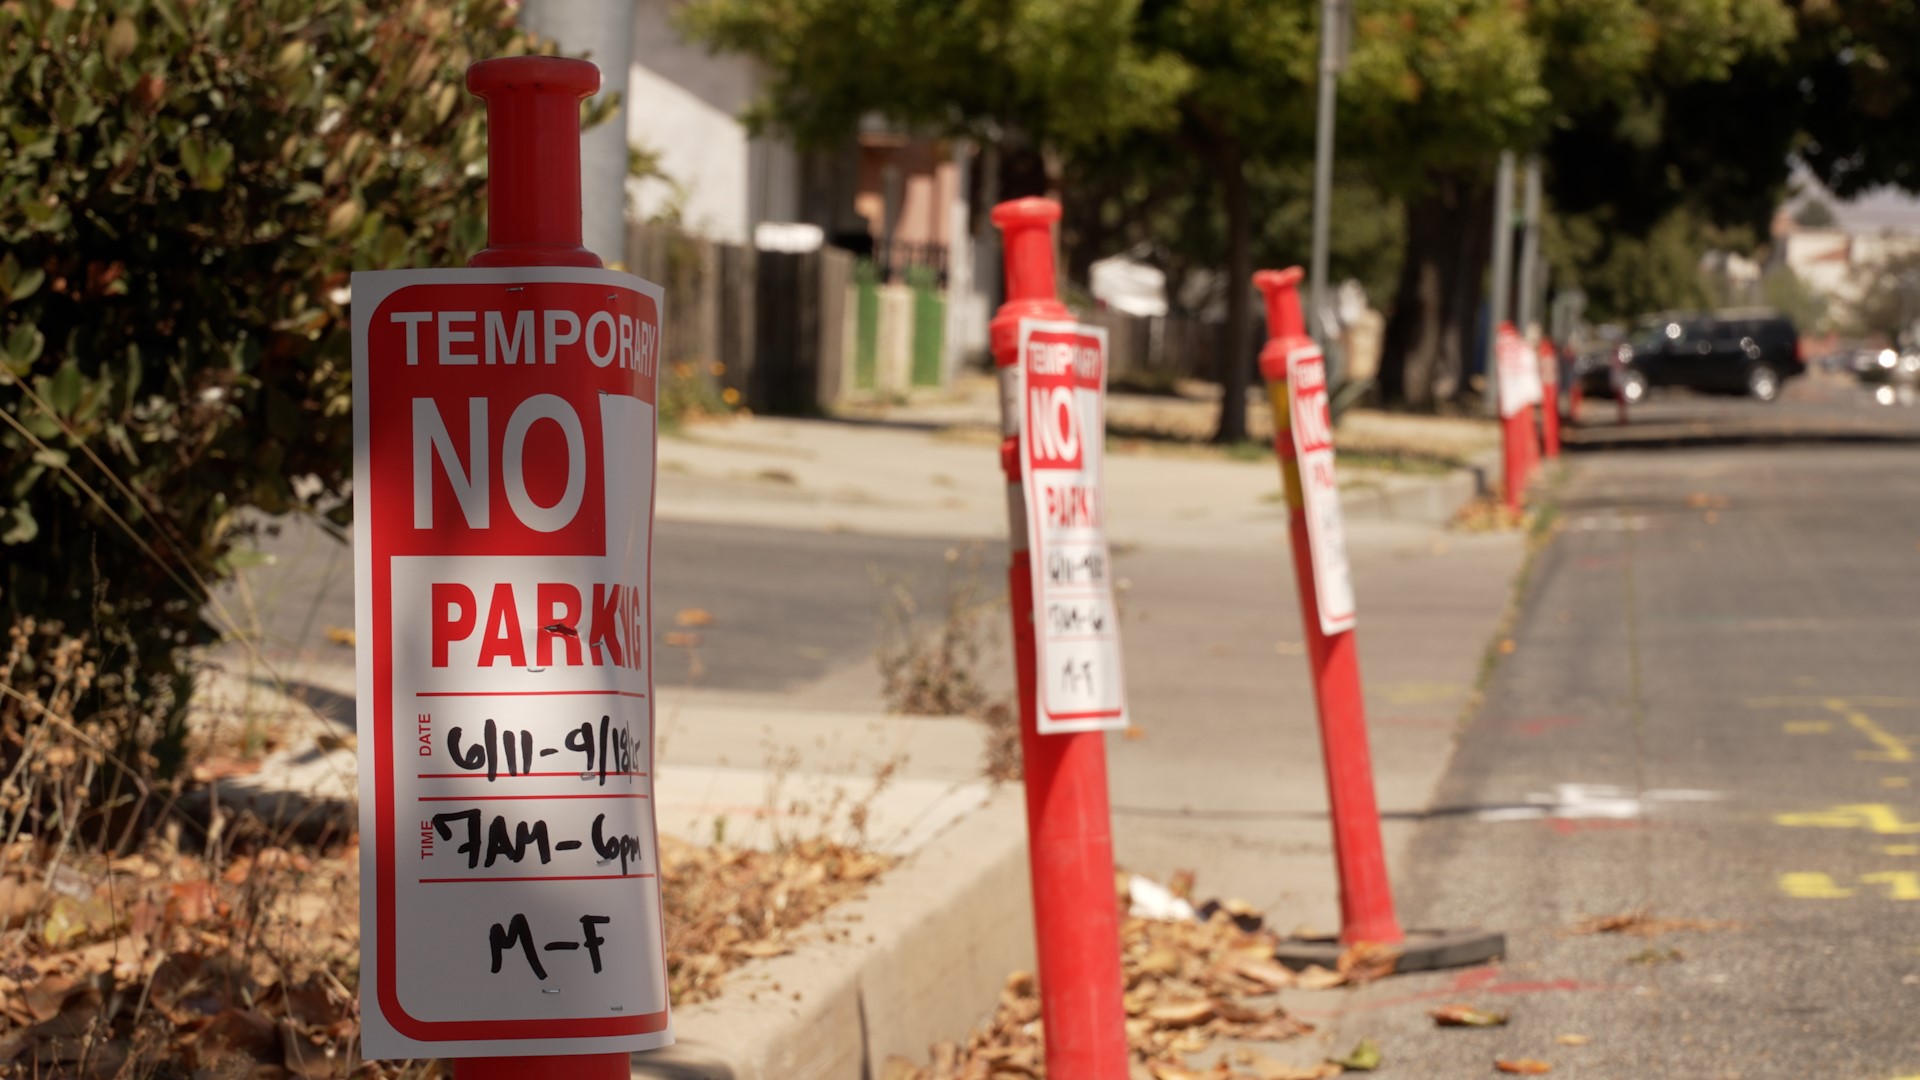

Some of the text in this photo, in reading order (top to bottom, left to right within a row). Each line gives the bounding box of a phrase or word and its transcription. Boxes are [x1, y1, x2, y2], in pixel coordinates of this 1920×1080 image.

[390, 309, 656, 377] TEMPORARY
[1030, 386, 1079, 462] NO
[412, 393, 587, 533] NO
[431, 583, 642, 671] PARKNG
[418, 713, 432, 757] DATE
[420, 820, 434, 860] TIME
